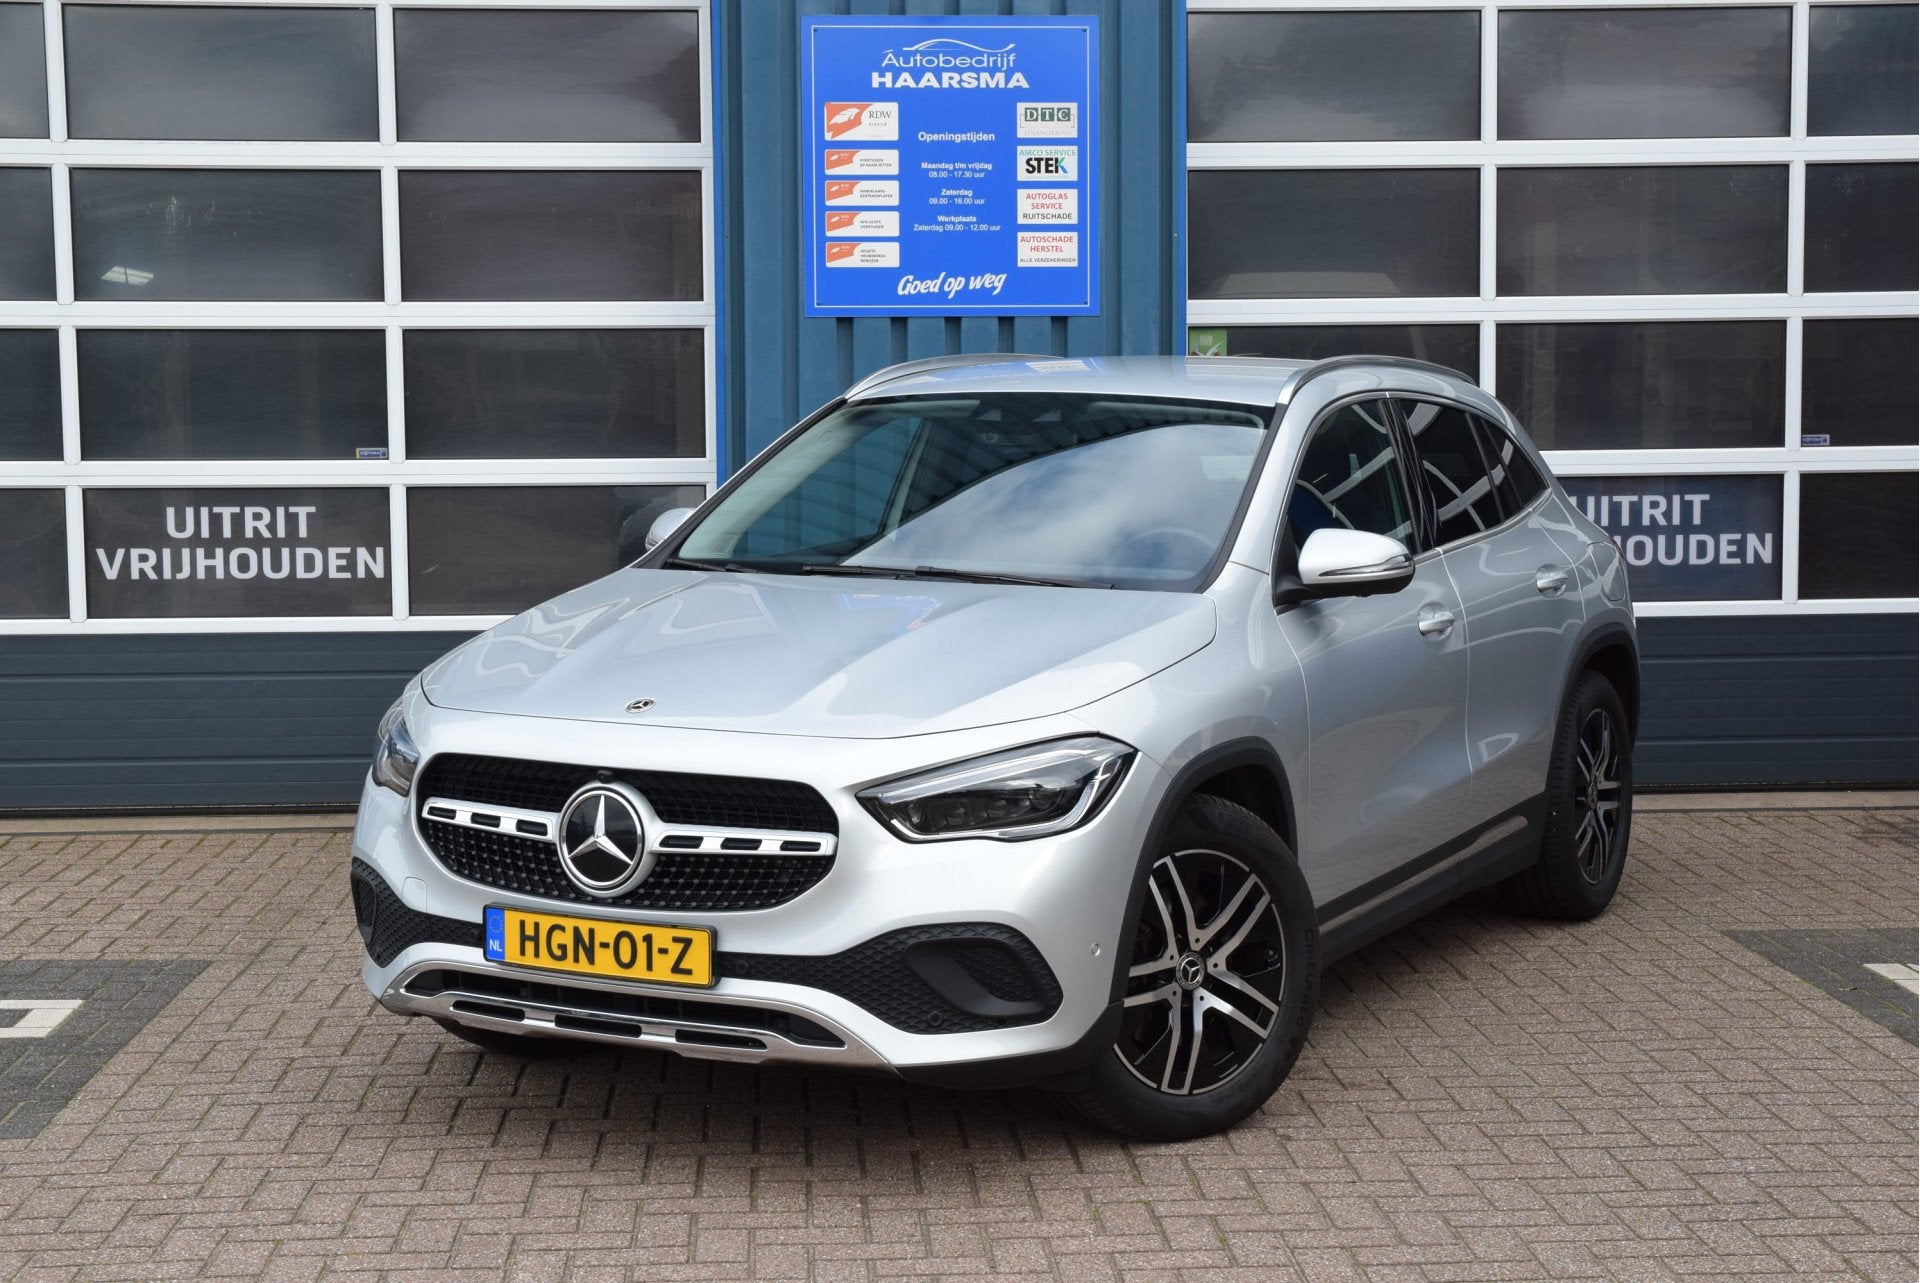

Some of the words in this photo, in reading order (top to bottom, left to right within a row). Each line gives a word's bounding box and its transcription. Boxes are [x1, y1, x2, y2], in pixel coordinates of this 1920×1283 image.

[882, 53, 1016, 71] Autobedrijf
[871, 72, 1030, 88] HAARSMA
[869, 110, 892, 119] RDW
[1025, 107, 1070, 121] DTC
[918, 131, 995, 143] Openingstijden
[921, 162, 953, 170] Maandag
[968, 162, 992, 170] vrijdag
[1025, 157, 1068, 174] STEK
[941, 188, 973, 197] Zaterdag
[937, 215, 977, 223] Werkplaats
[1023, 212, 1072, 220] RUITSCHADE
[913, 224, 943, 232] Zaterdag
[897, 271, 946, 296] Goed
[943, 276, 966, 300] op
[968, 273, 1008, 296] weg
[166, 506, 316, 539] UITRIT
[1617, 533, 1773, 566] OUDEN
[96, 546, 385, 580] VRIJHOUDEN
[489, 939, 503, 952] NL
[519, 919, 693, 976] HGN-01-Z
